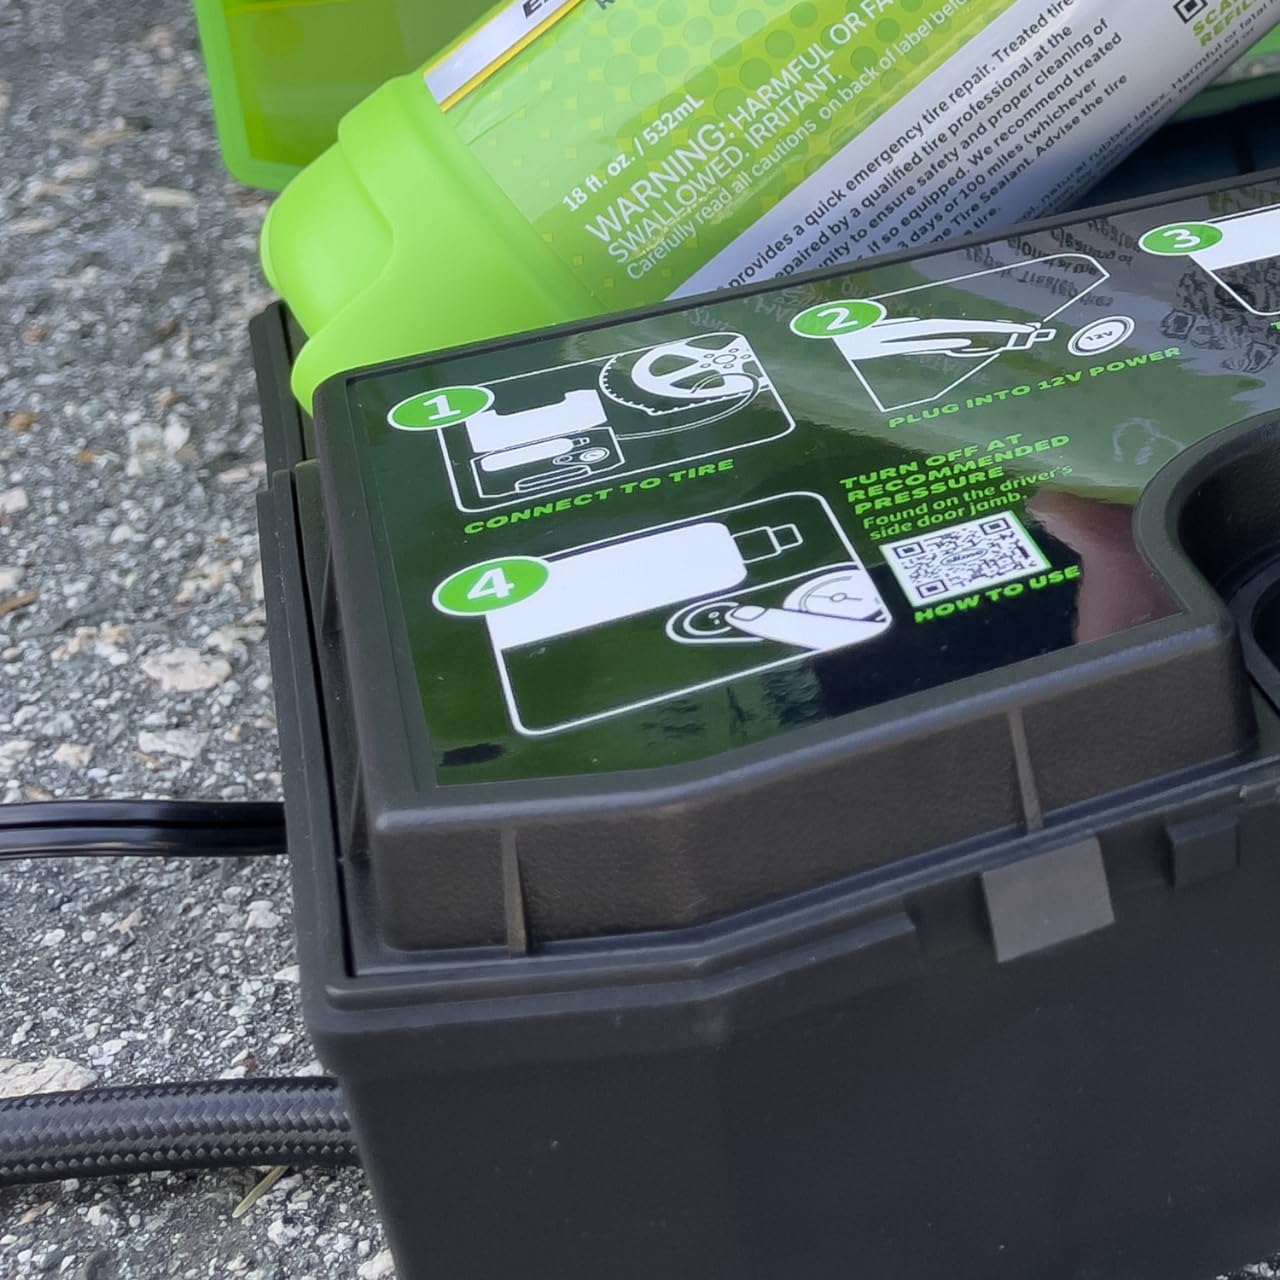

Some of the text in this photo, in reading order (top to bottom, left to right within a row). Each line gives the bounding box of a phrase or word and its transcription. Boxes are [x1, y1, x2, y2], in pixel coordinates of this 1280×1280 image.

[561, 186, 588, 211] 18
[606, 152, 635, 176] oz.
[641, 93, 704, 145] 532mL
[584, 121, 734, 242] WARNING:
[726, 42, 834, 130] HARMFUL
[828, 11, 867, 45] OR
[607, 62, 842, 263] SWALLOWED. IRRITANT.
[626, 218, 696, 279] Carefully
[694, 186, 733, 224] read
[730, 170, 752, 194] all
[751, 118, 817, 176] cautions
[818, 98, 842, 120] on
[838, 65, 880, 102] back
[878, 47, 896, 70] of
[891, 17, 933, 56] label
[727, 231, 794, 289] provides
[792, 224, 805, 236] a
[803, 188, 847, 226] quick
[845, 120, 924, 191] emergency
[921, 100, 949, 124] tire
[947, 63, 996, 104] repair.
[990, 12, 1048, 63] Treated
[827, 215, 850, 236] by
[849, 206, 861, 218] a
[860, 150, 923, 209] qualified
[920, 132, 948, 156] tire
[946, 56, 1033, 137] professional
[1032, 44, 1050, 62] at
[1046, 26, 1072, 48] the
[848, 17, 1108, 243] to ensure safety and proper cleaning of
[866, 239, 881, 254] if
[880, 226, 899, 244] so
[899, 166, 970, 227] equipped.
[966, 145, 993, 166] We
[992, 73, 1073, 147] recommend
[1072, 31, 1122, 77] treated
[909, 212, 943, 242] days
[943, 196, 959, 213] or
[957, 173, 986, 200] 100
[986, 143, 1024, 177] miles
[1023, 78, 1096, 144] (whichever
[949, 74, 1127, 227] Tire Sealant. Advise the tire
[972, 207, 1001, 229] tire.
[1161, 227, 1201, 248] 3
[819, 307, 859, 332] 2
[422, 393, 461, 421] 1
[888, 346, 1181, 428] PLUG INTO 12V POWER
[463, 458, 734, 534] CONNECT TO TIRE
[838, 433, 1022, 489] TURN OFF AT
[847, 434, 1070, 502] RECOMMENDED
[854, 465, 1004, 515] PRESSURE
[862, 462, 1074, 529] Found on the driver's
[869, 492, 1027, 540] side door jamb.
[466, 567, 515, 601] 4
[914, 564, 1080, 623] HOW TO USE
